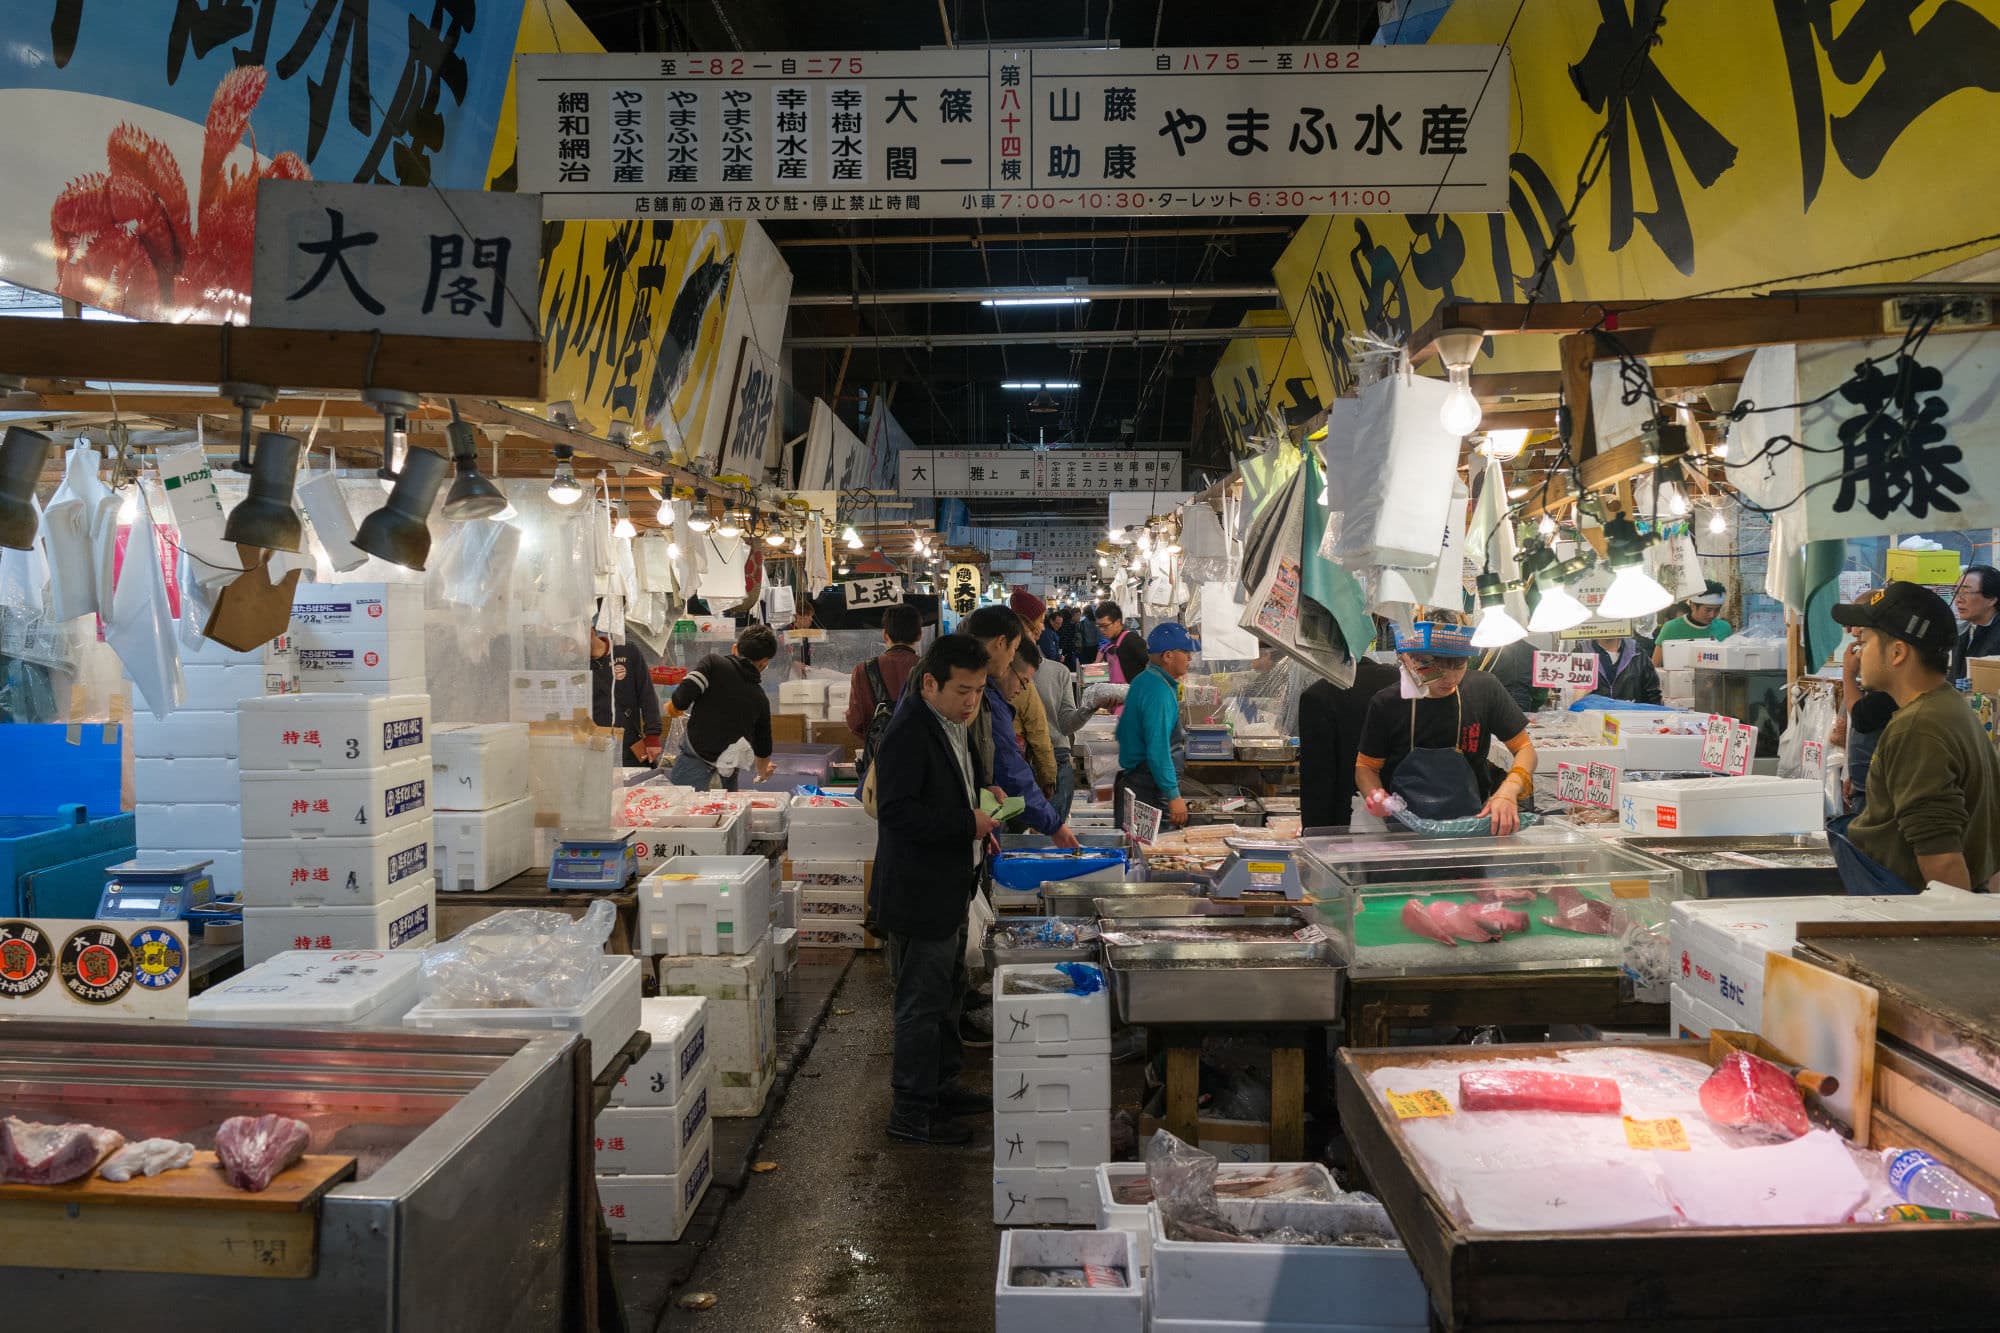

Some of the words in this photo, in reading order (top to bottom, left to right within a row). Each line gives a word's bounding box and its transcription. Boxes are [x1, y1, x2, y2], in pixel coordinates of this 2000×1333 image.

[612, 90, 644, 183] やまふ水産
[667, 90, 699, 183] やまふ水産
[721, 90, 753, 182] やまふ水産
[776, 88, 807, 180] 幸樹水産
[831, 89, 863, 181] 幸樹水産
[1000, 65, 1022, 181] 第八十四棟
[1048, 88, 1081, 180] 山助
[1158, 103, 1468, 157] やまふ水産
[287, 207, 512, 328] 大閣
[1832, 353, 1971, 521] 藤
[849, 578, 898, 604] 上武
[282, 731, 321, 745] 特選
[345, 738, 360, 759] 3
[292, 800, 331, 814] 特選
[354, 805, 368, 825] 4
[292, 868, 331, 882] 特選
[295, 936, 333, 950] 特選
[650, 1072, 669, 1093] 3
